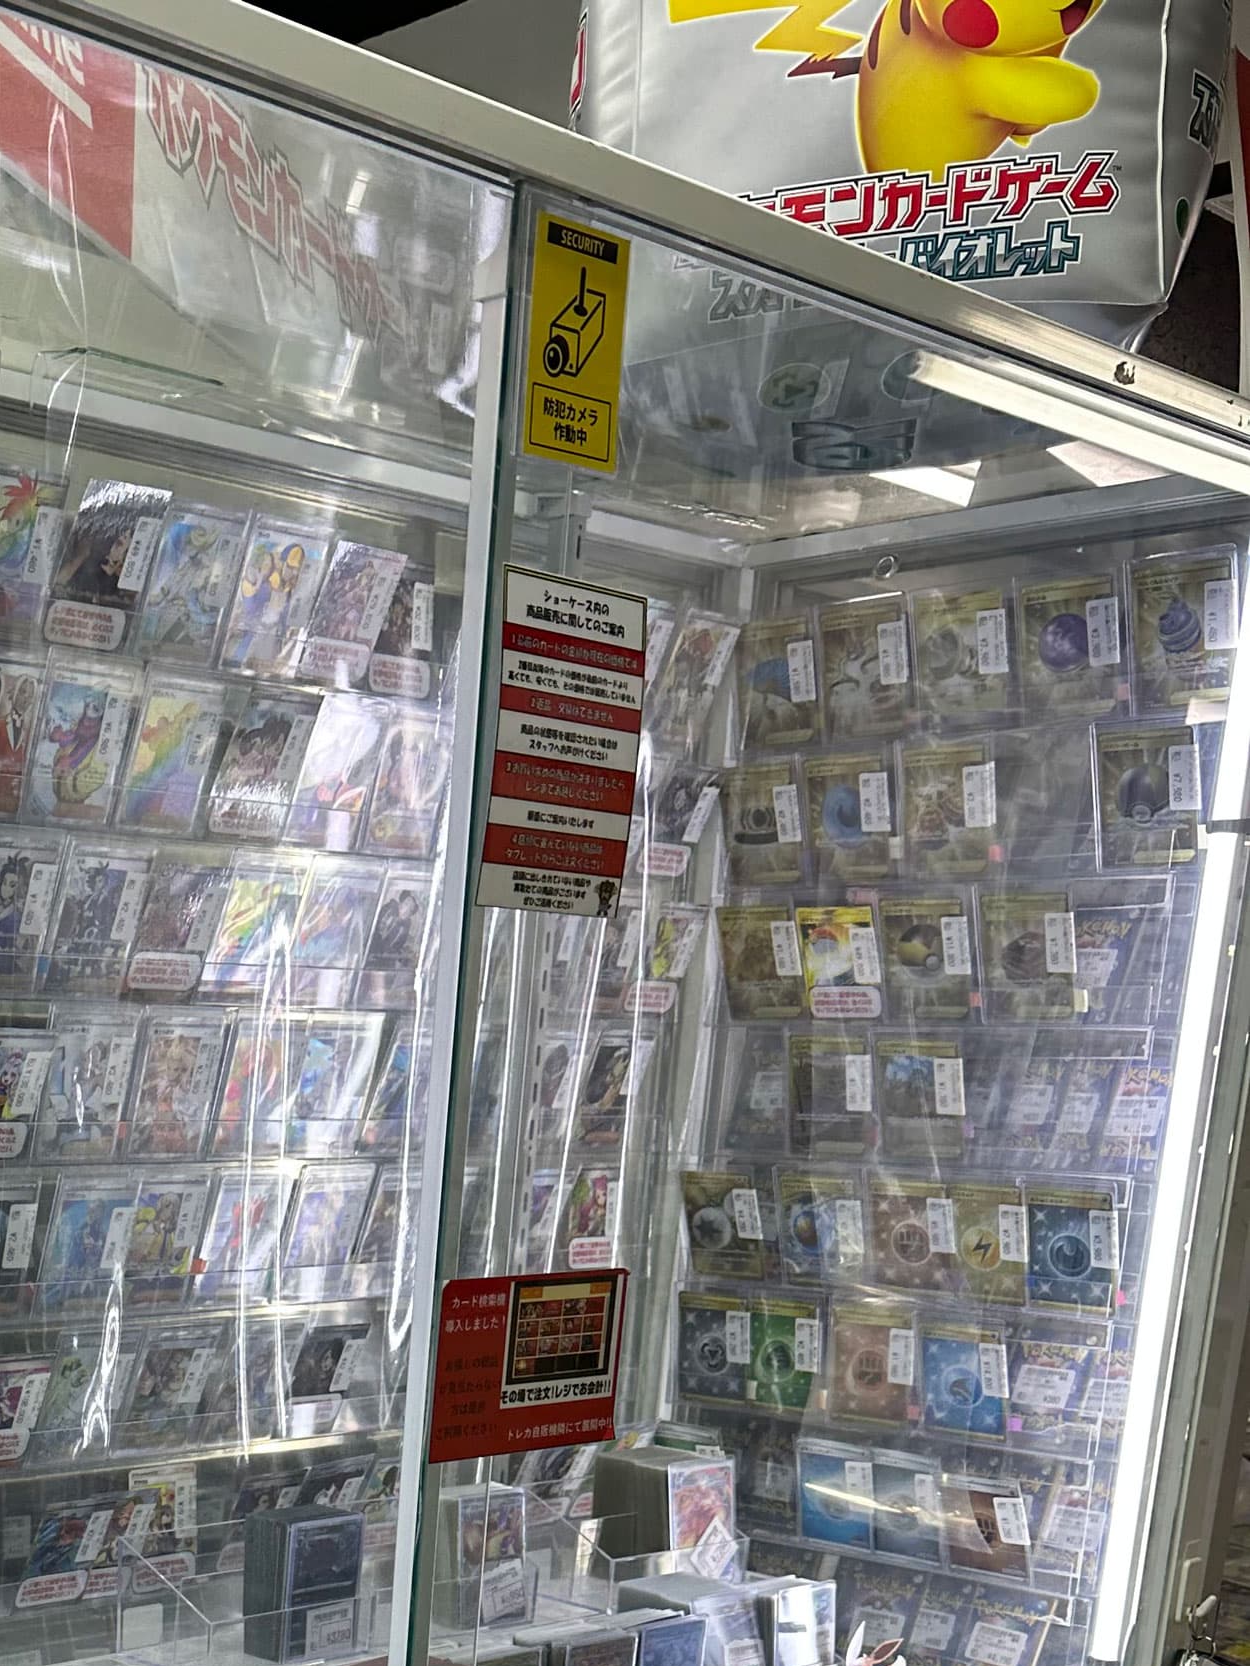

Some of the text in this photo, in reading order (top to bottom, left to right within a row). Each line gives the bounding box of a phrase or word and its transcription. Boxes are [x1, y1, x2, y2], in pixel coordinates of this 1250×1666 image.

[745, 152, 1120, 236] モンカードゲーム
[560, 229, 606, 257] SECURITY
[543, 396, 599, 427] 防犯カメラ
[553, 421, 588, 447] 作動中
[543, 588, 610, 616] ショーケース内の
[526, 603, 626, 639] 商品販売に関してのご案内
